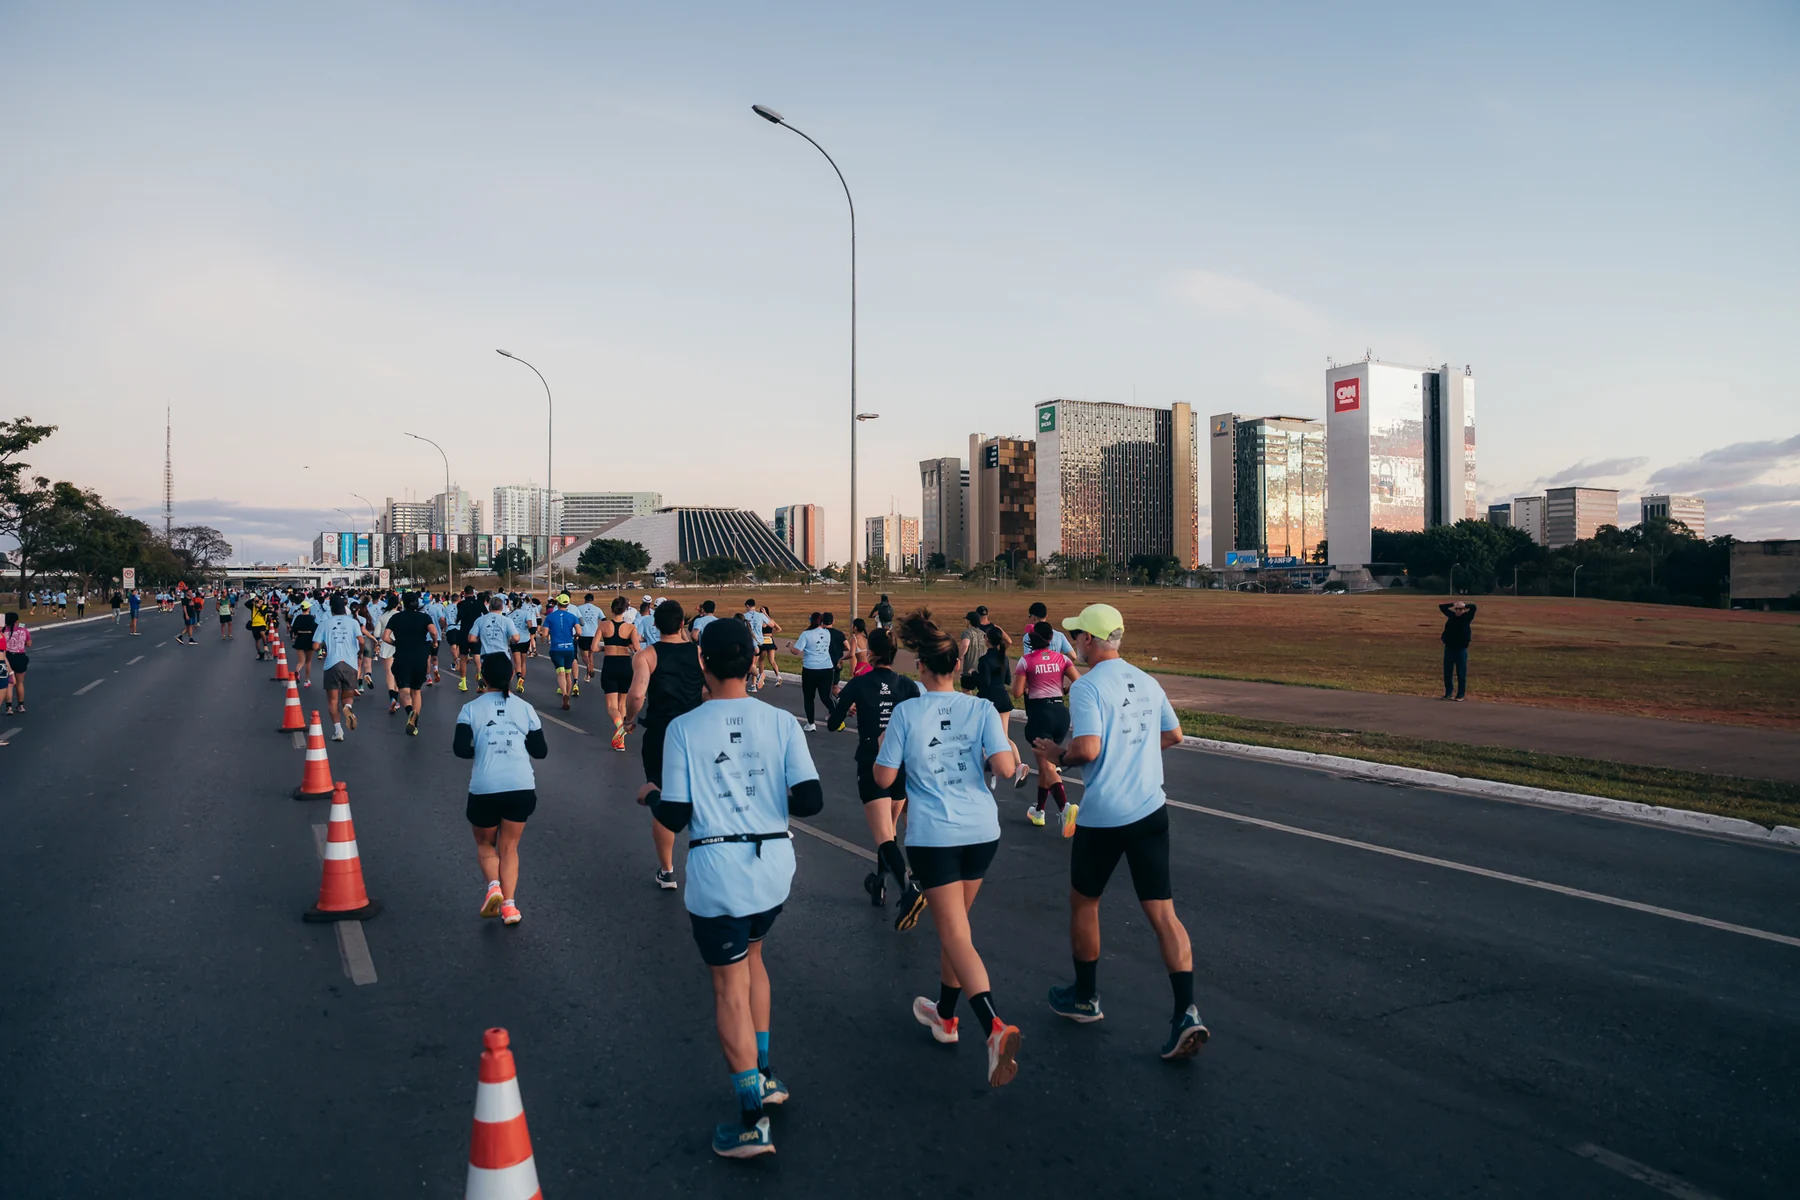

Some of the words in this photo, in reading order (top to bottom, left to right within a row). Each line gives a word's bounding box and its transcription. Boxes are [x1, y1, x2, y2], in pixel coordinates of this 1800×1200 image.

[1035, 663, 1061, 674] ATLETA
[726, 717, 743, 725] LIVE!
[739, 1130, 759, 1141] HOKA
